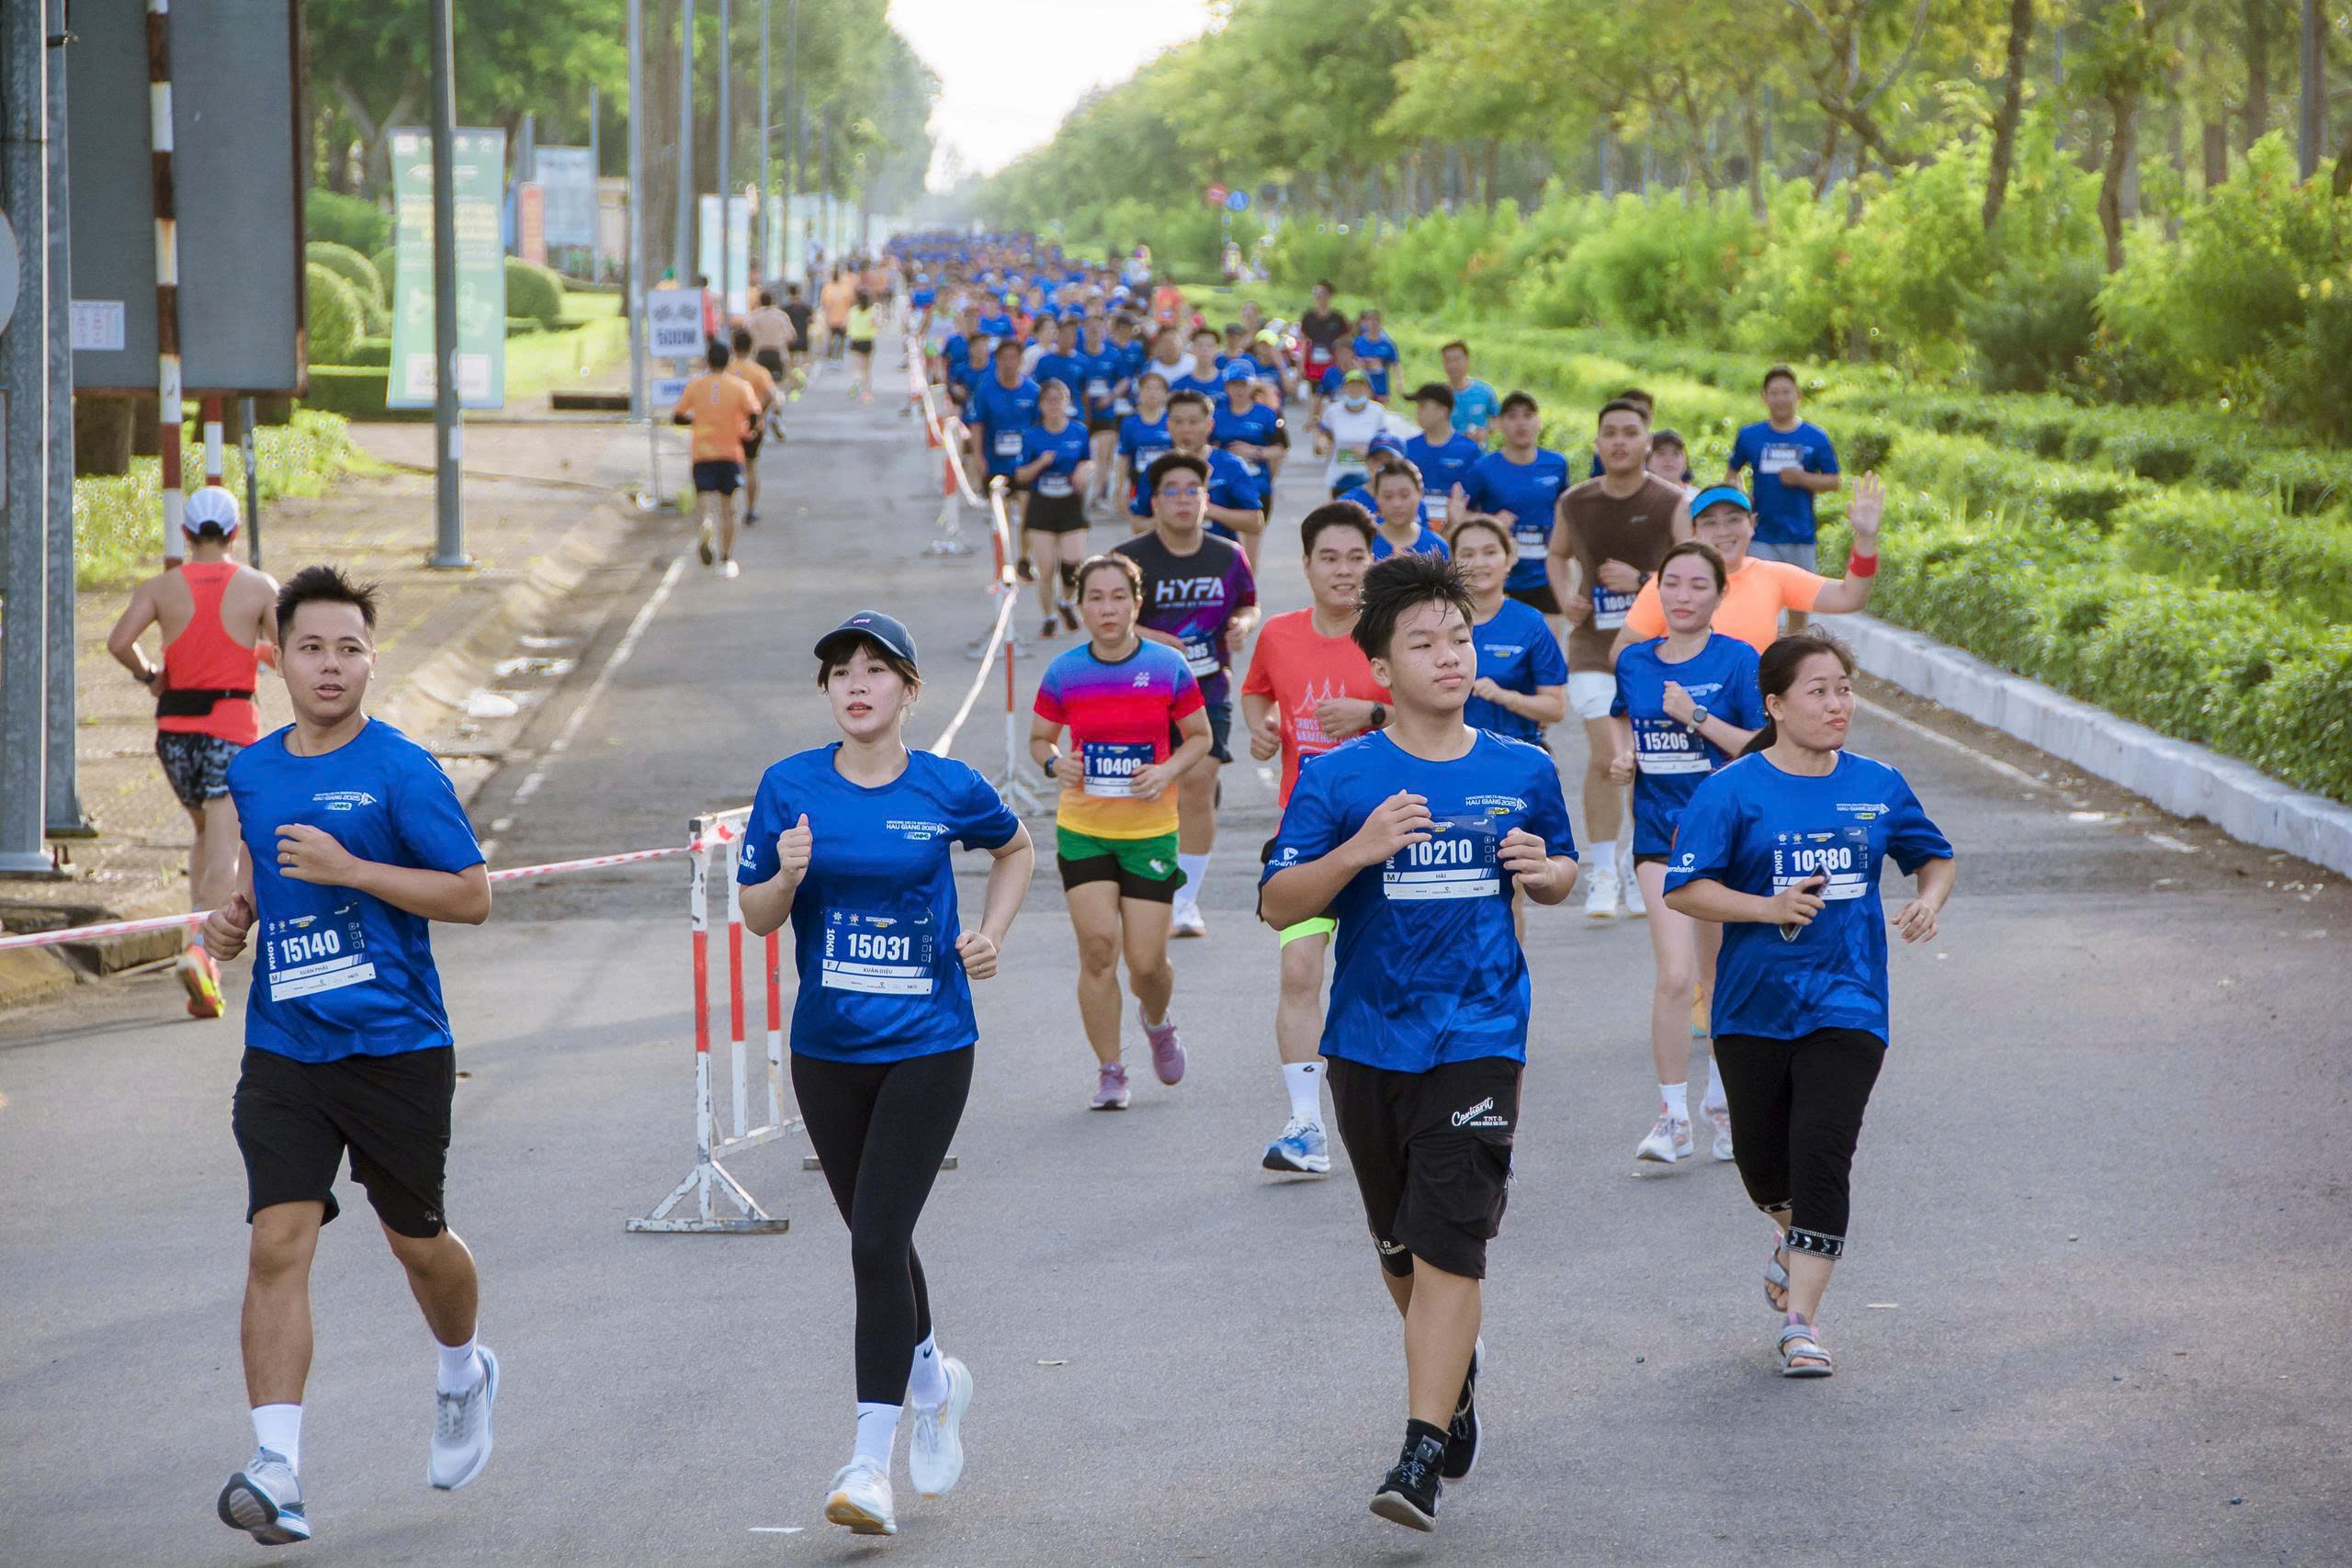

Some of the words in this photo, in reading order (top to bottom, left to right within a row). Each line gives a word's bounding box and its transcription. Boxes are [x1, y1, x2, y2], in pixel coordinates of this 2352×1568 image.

[1644, 732, 1690, 750] 15206
[1407, 839, 1473, 866] 10210
[1773, 850, 1783, 875] 10KM
[1792, 847, 1852, 872] 10380
[267, 940, 277, 971] 10KM
[281, 930, 341, 964] 15140
[826, 928, 836, 958] 10KM
[848, 932, 910, 961] 15031
